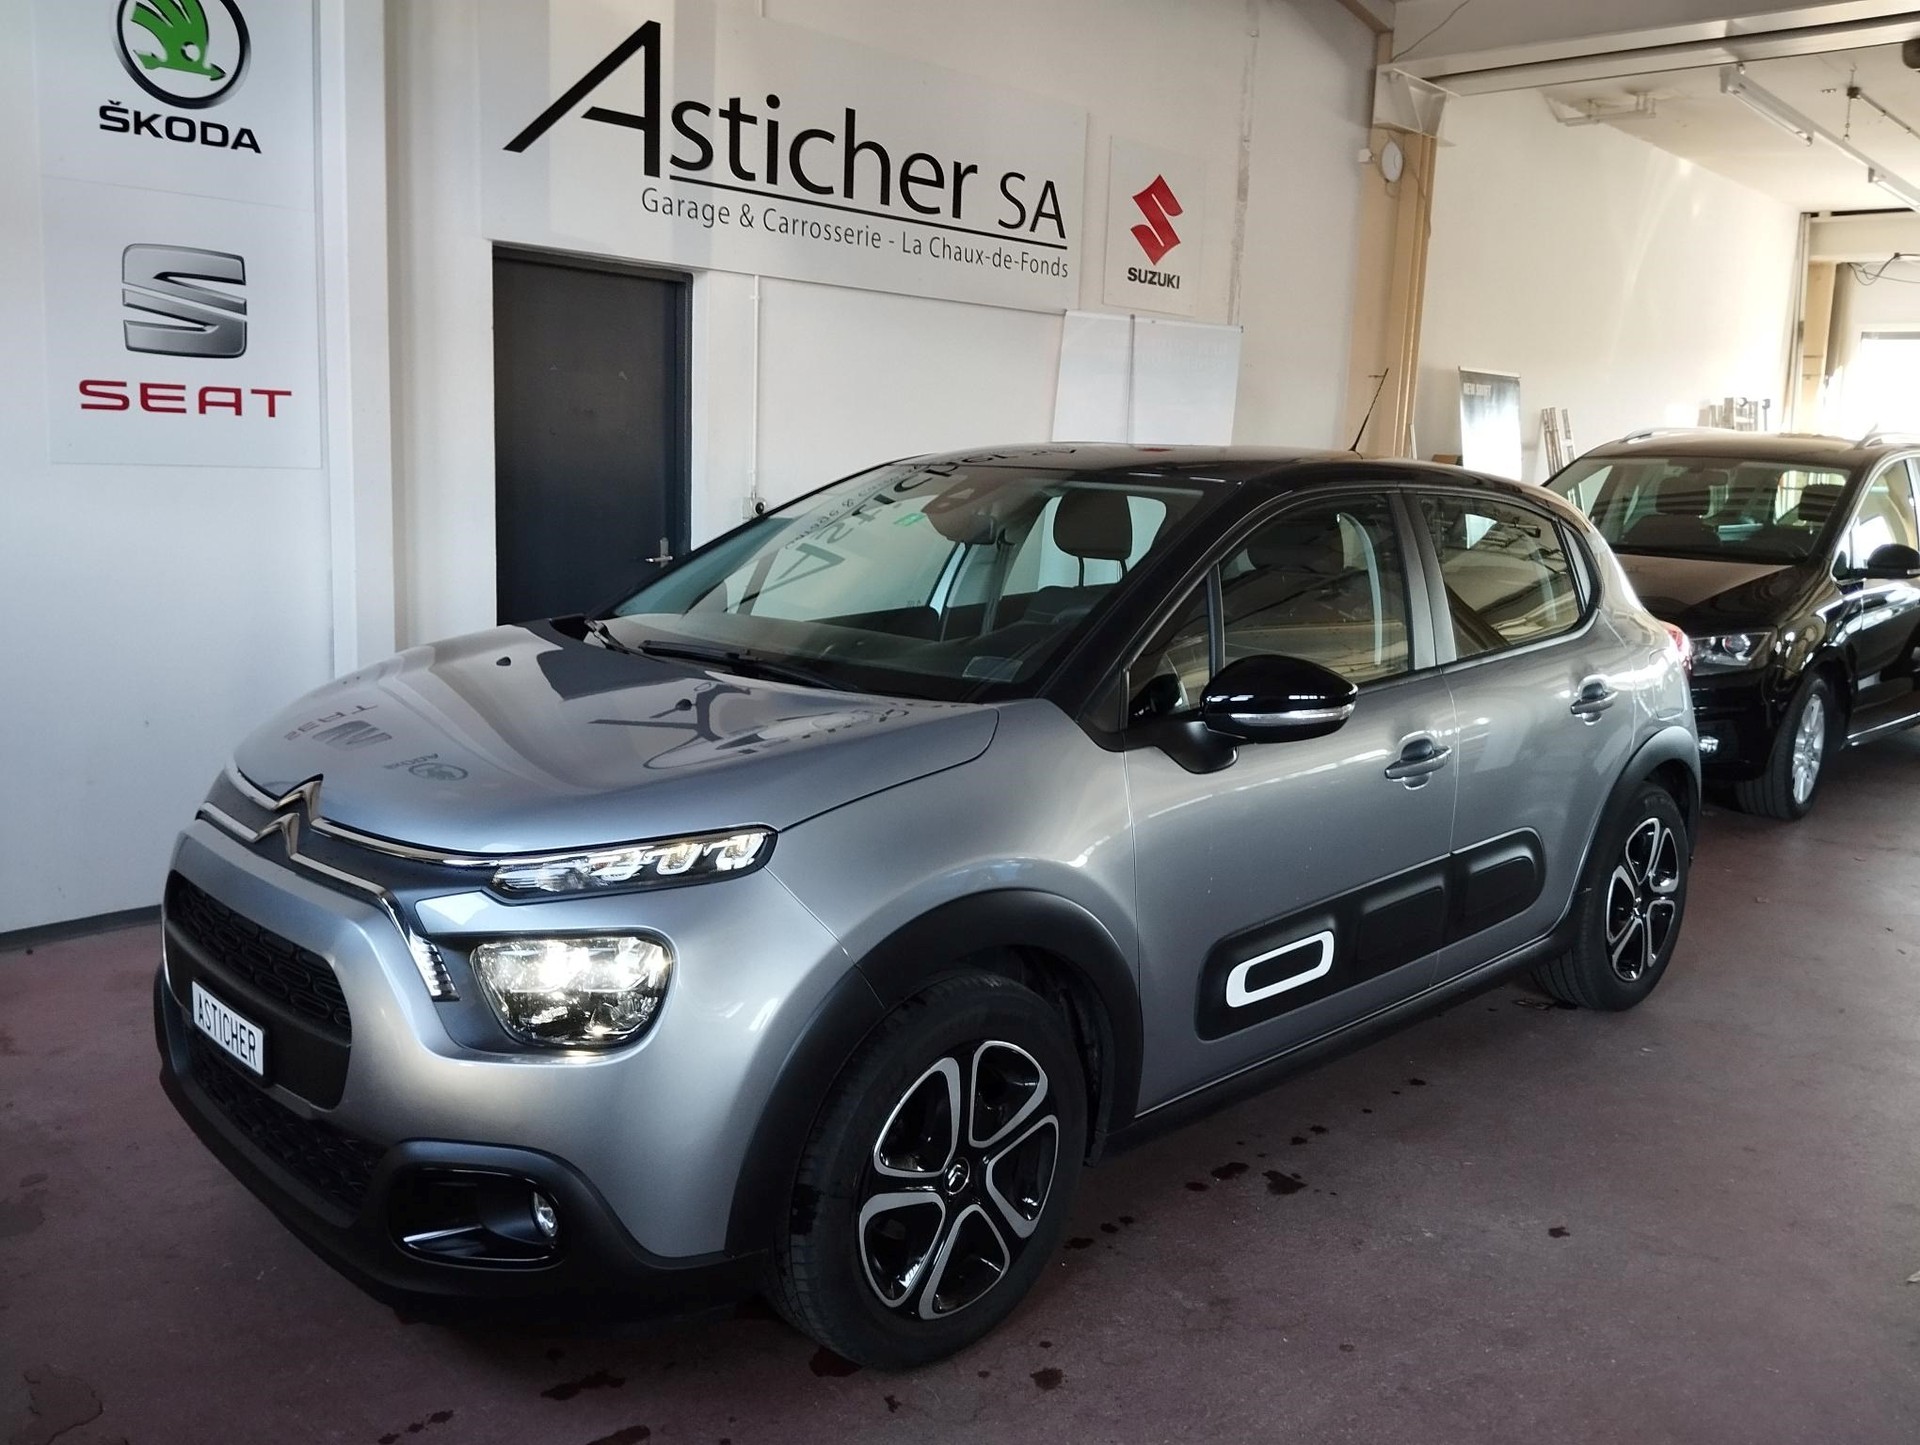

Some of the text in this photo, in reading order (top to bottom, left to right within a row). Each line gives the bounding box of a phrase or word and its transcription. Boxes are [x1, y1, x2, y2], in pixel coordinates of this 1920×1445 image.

[98, 99, 262, 154] ŠKODA
[503, 19, 1068, 240] Asticher SA
[641, 187, 730, 229] Garage
[739, 203, 754, 229] &
[763, 208, 882, 249] Carrosserie
[902, 231, 922, 256] La
[929, 236, 1069, 279] Chaux-de-Fonds
[1127, 266, 1180, 290] SUZUKI
[78, 379, 292, 418] SEAT
[198, 992, 257, 1067] ASTICHER
